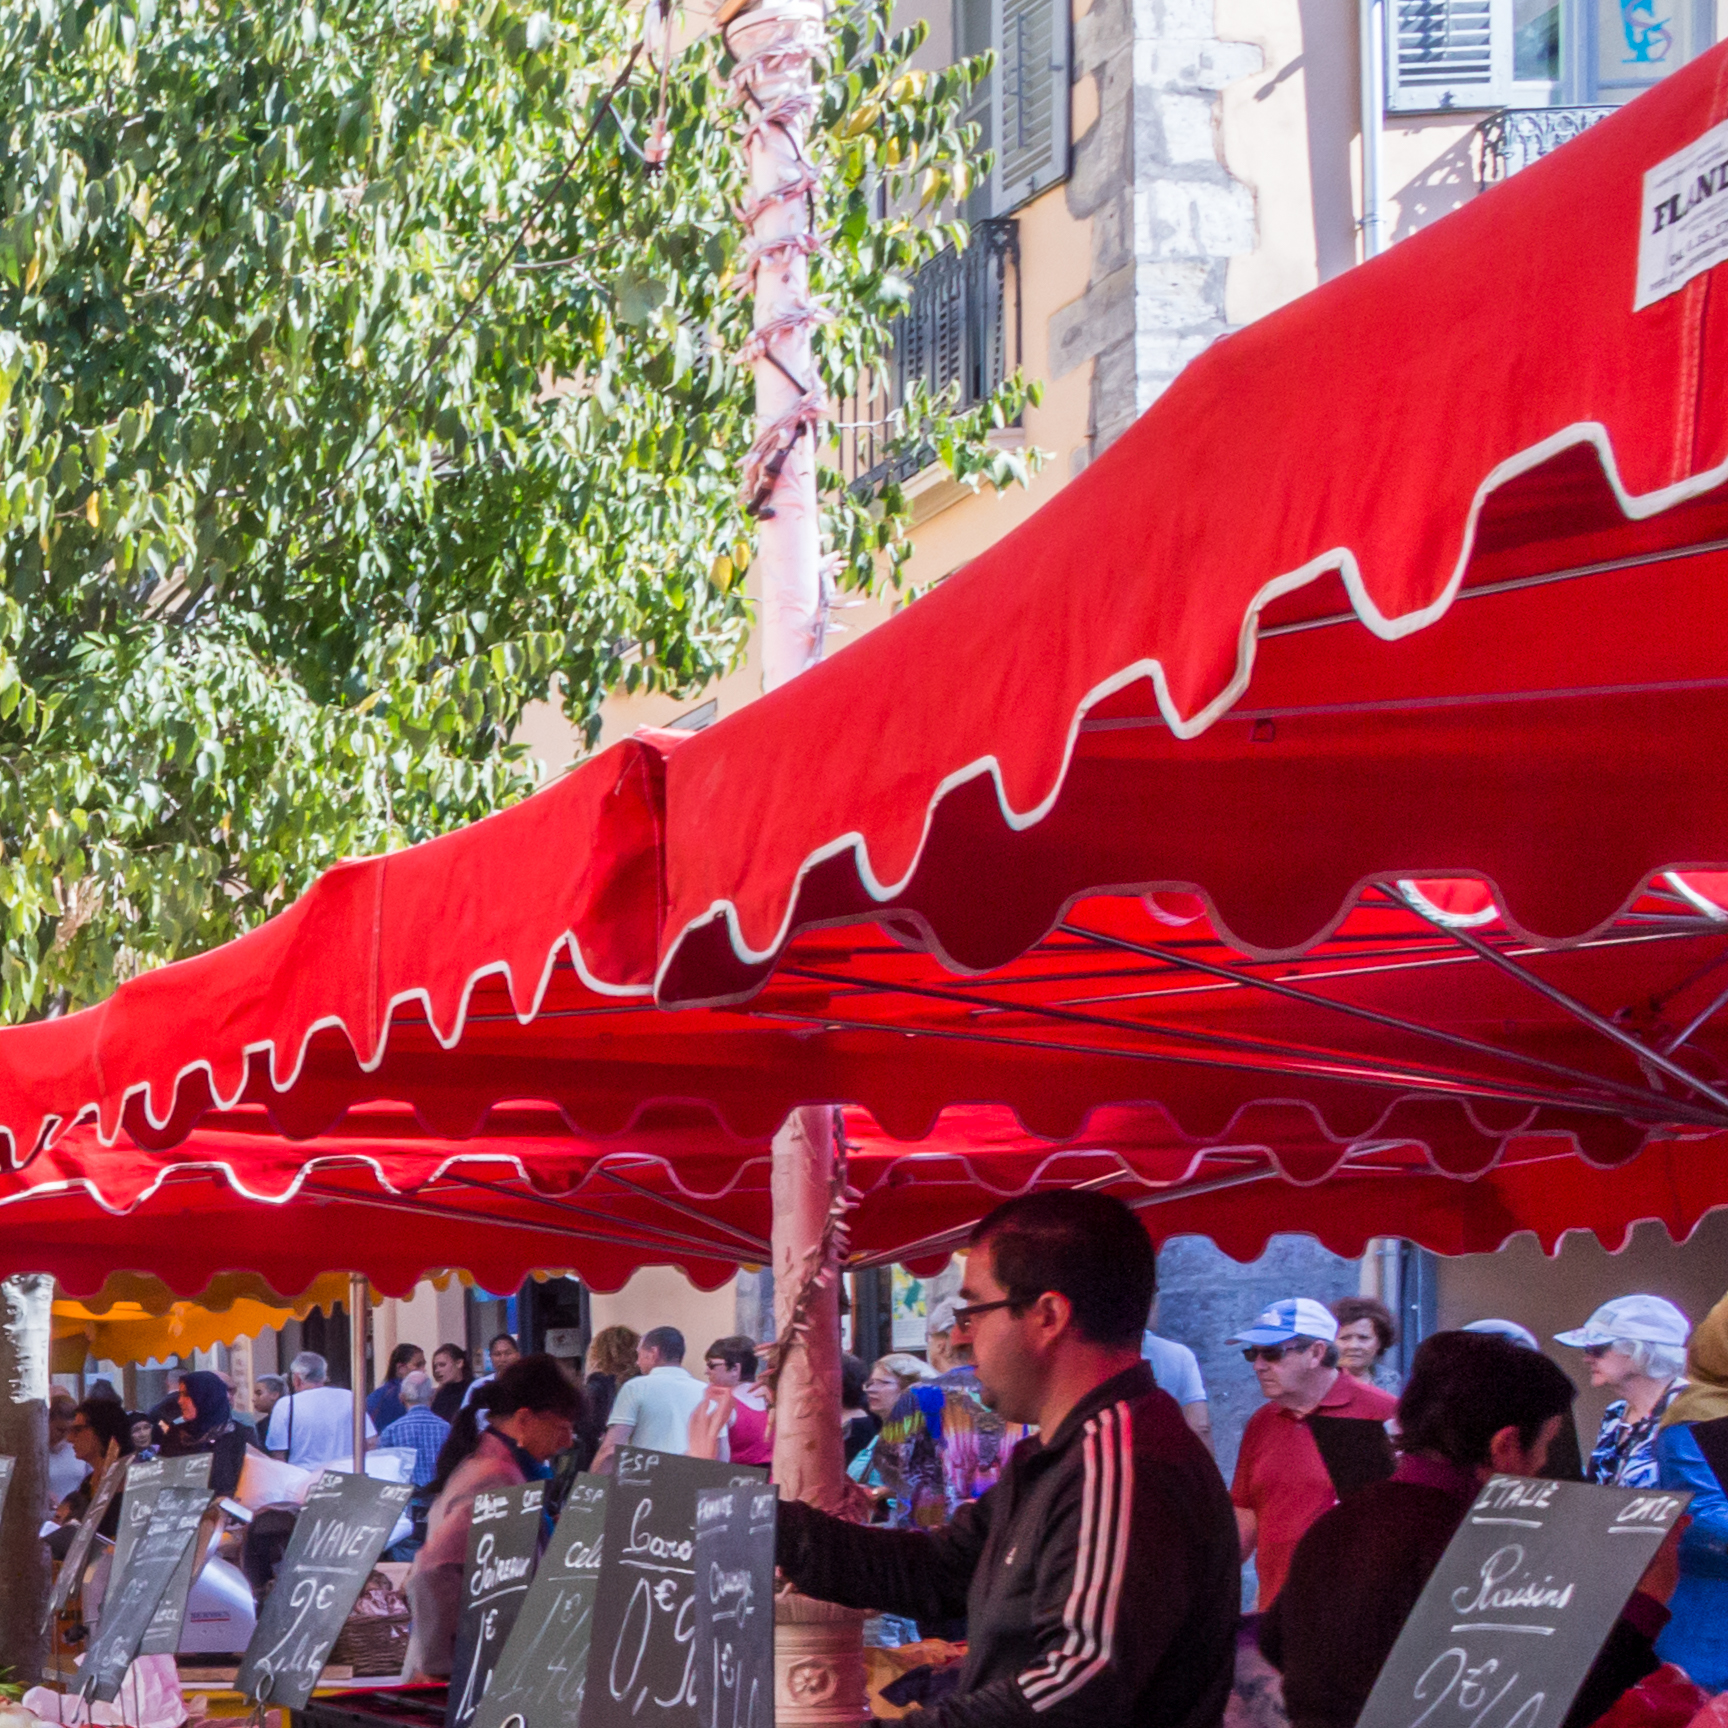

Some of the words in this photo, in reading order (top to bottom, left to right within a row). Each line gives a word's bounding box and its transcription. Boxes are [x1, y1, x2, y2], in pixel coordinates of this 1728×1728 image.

[618, 1451, 660, 1475] ESP
[302, 1518, 386, 1559] NAVET
[1451, 1543, 1575, 1614] Raisins
